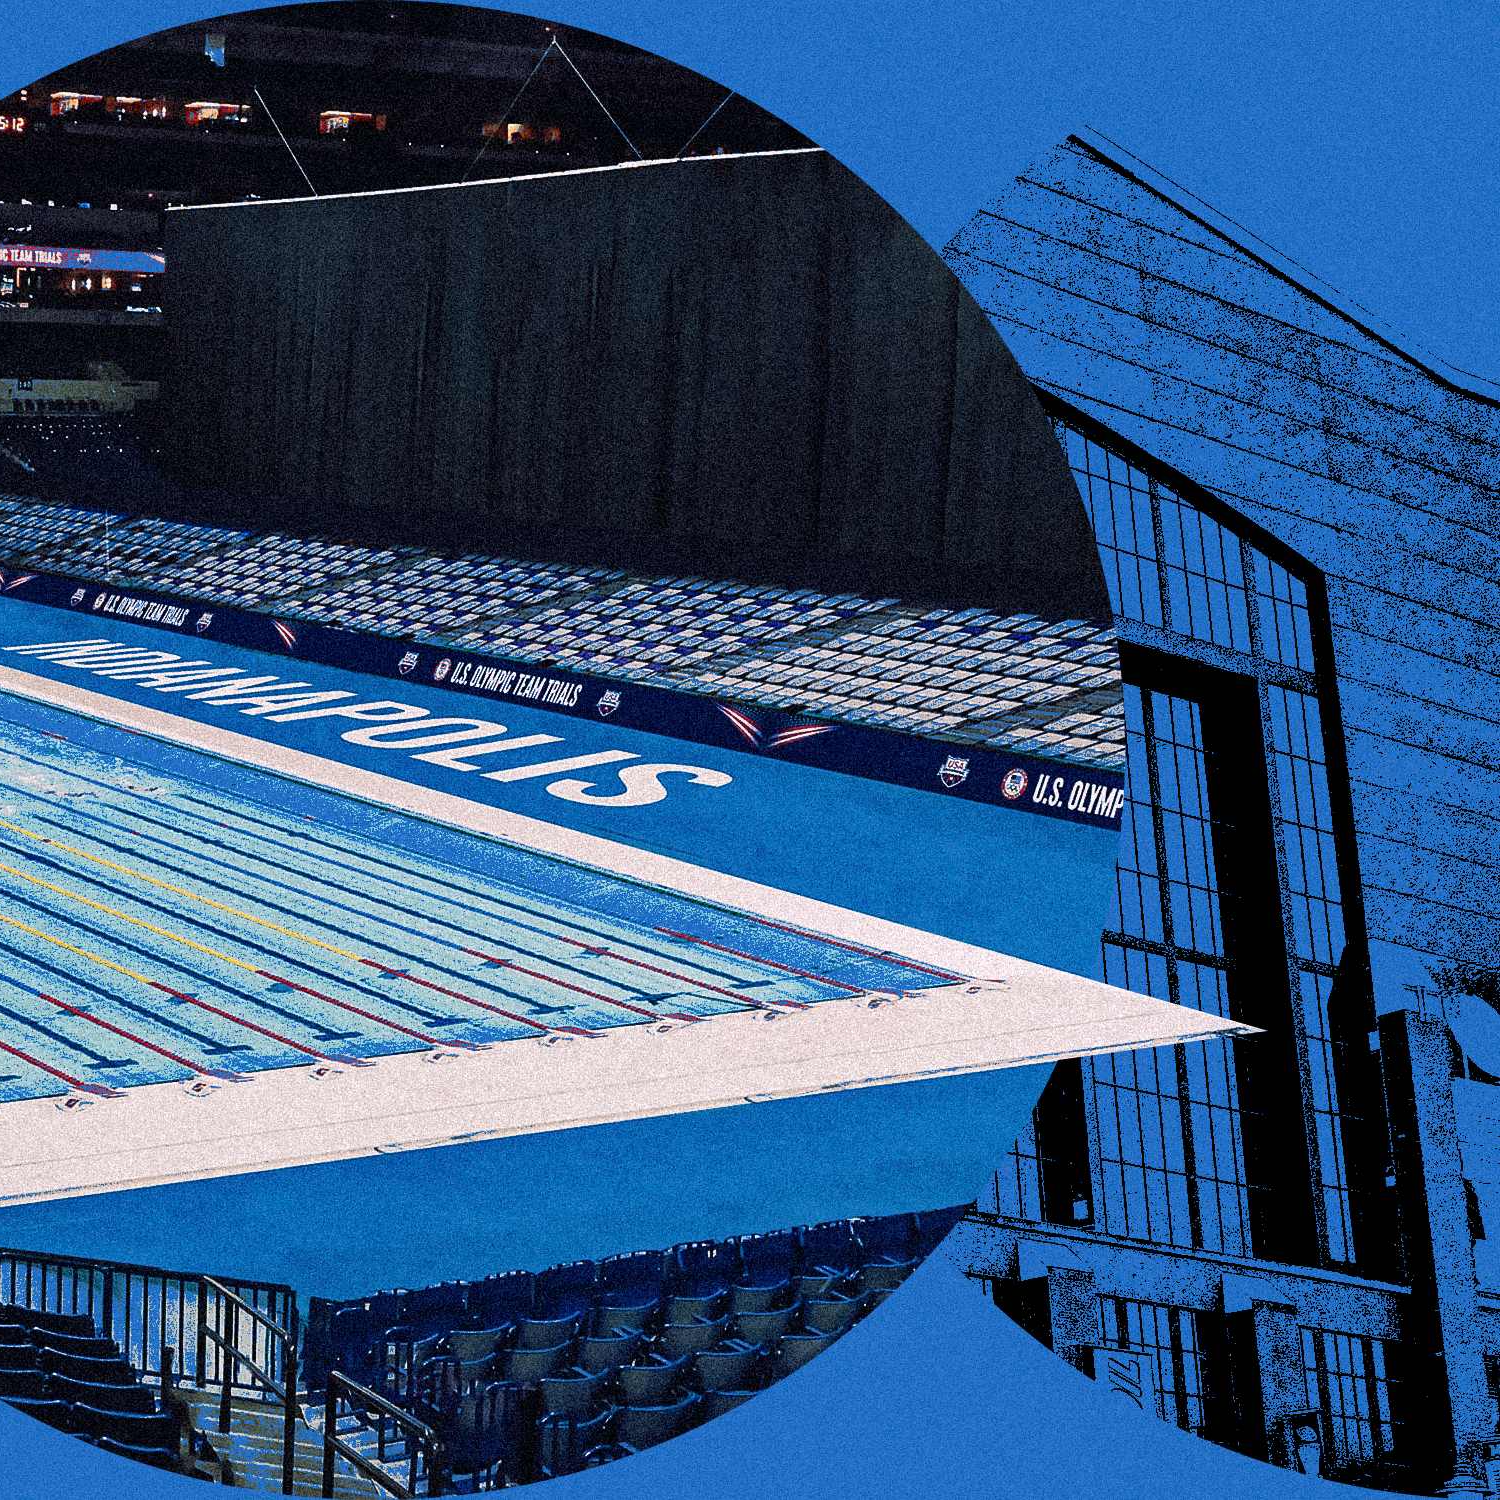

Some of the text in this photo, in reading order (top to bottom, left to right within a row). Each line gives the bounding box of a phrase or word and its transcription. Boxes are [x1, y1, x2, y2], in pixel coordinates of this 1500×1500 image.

[10, 249, 34, 263] TEAM
[450, 661, 584, 708] U.S. OLYMPIC TEAM TRIALS
[0, 638, 734, 806] INDIANAPOLIS
[1032, 773, 1065, 808] U.S.
